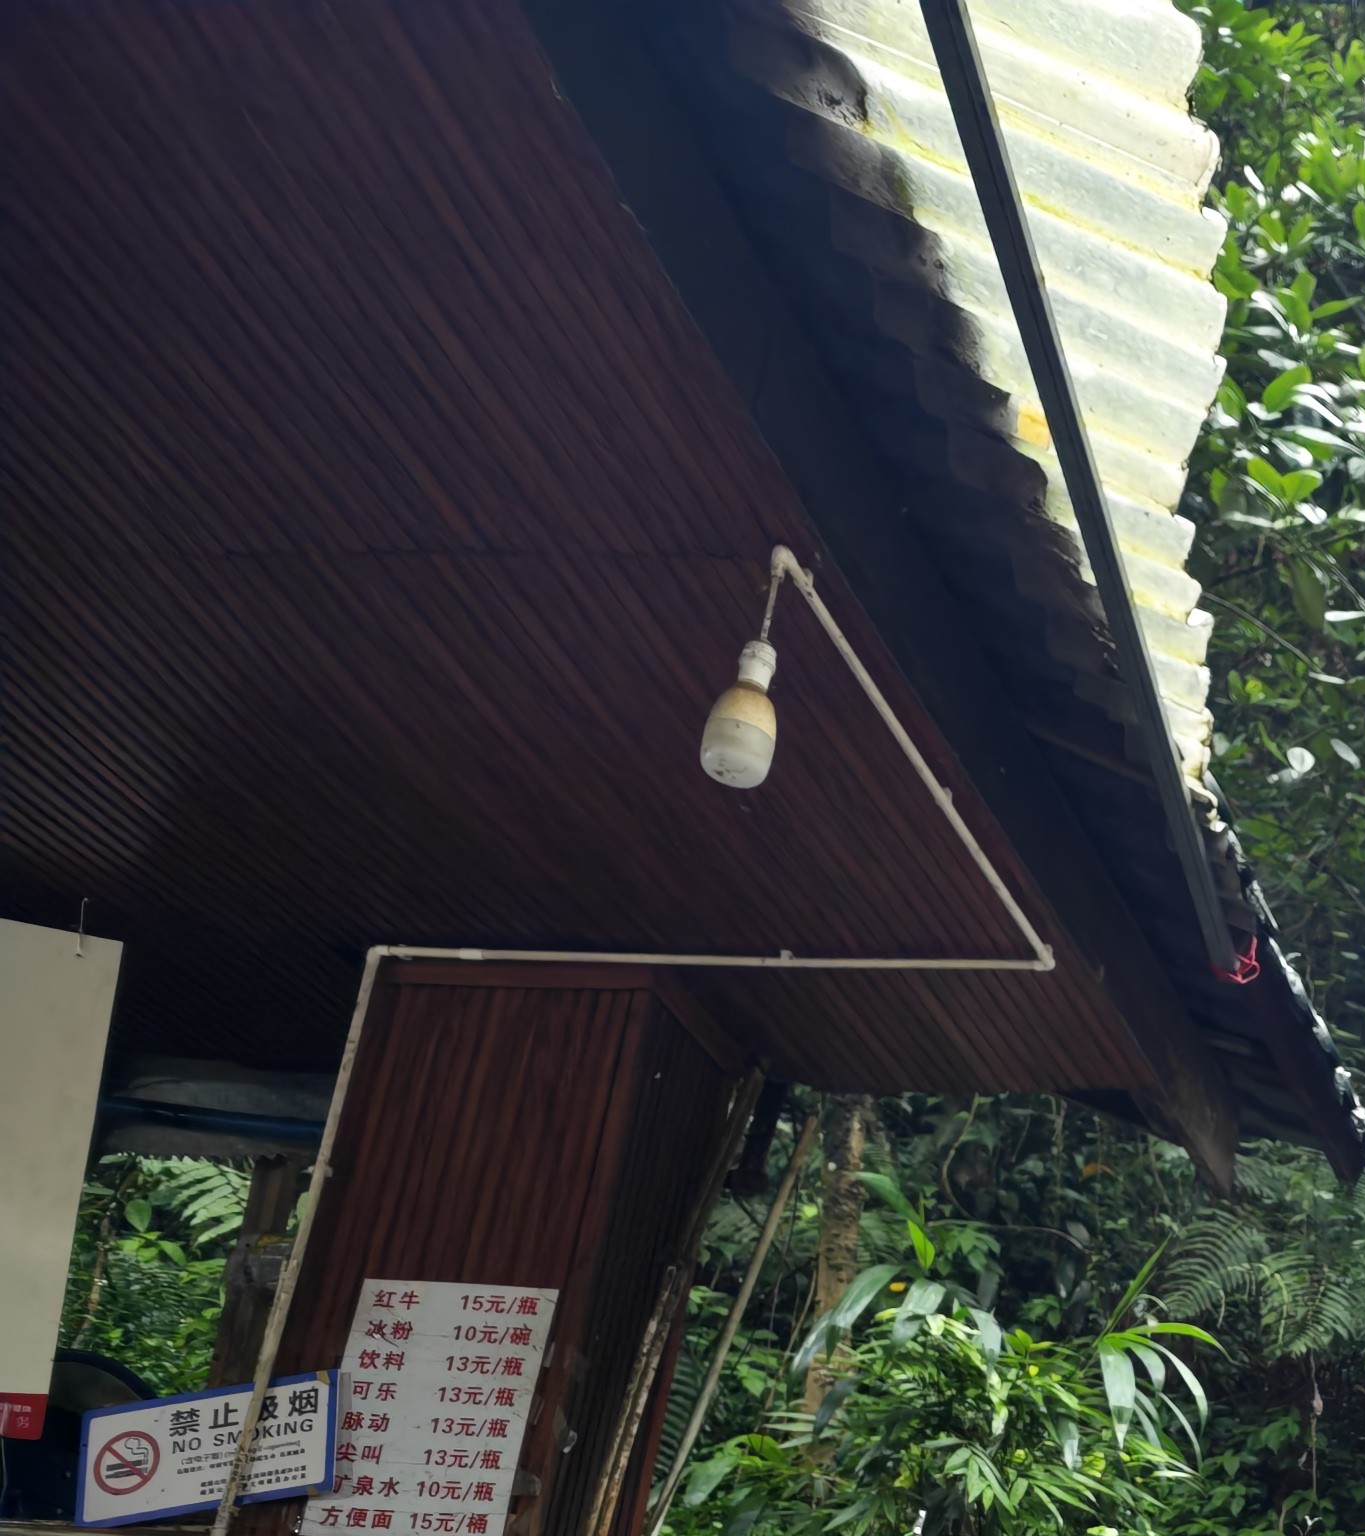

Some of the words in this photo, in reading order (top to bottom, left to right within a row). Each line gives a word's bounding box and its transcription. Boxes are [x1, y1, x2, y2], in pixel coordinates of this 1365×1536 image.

[373, 1290, 420, 1310] 红牛
[460, 1295, 540, 1315] 15元/瓶
[365, 1320, 413, 1340] 冰粉
[453, 1324, 532, 1345] 10元/碗
[358, 1350, 405, 1370] 饮料
[445, 1356, 526, 1376] 13元/瓶
[353, 1381, 397, 1400] 可乐
[437, 1386, 518, 1407] 13元/瓶
[341, 1412, 390, 1432] 脉动
[430, 1417, 510, 1438] 13元/瓶
[172, 1438, 201, 1454] NO
[423, 1449, 503, 1470] 13元/瓶
[416, 1481, 496, 1502] 10元/瓶
[319, 1506, 394, 1529] 方便面
[409, 1513, 489, 1534] 15元/桶
